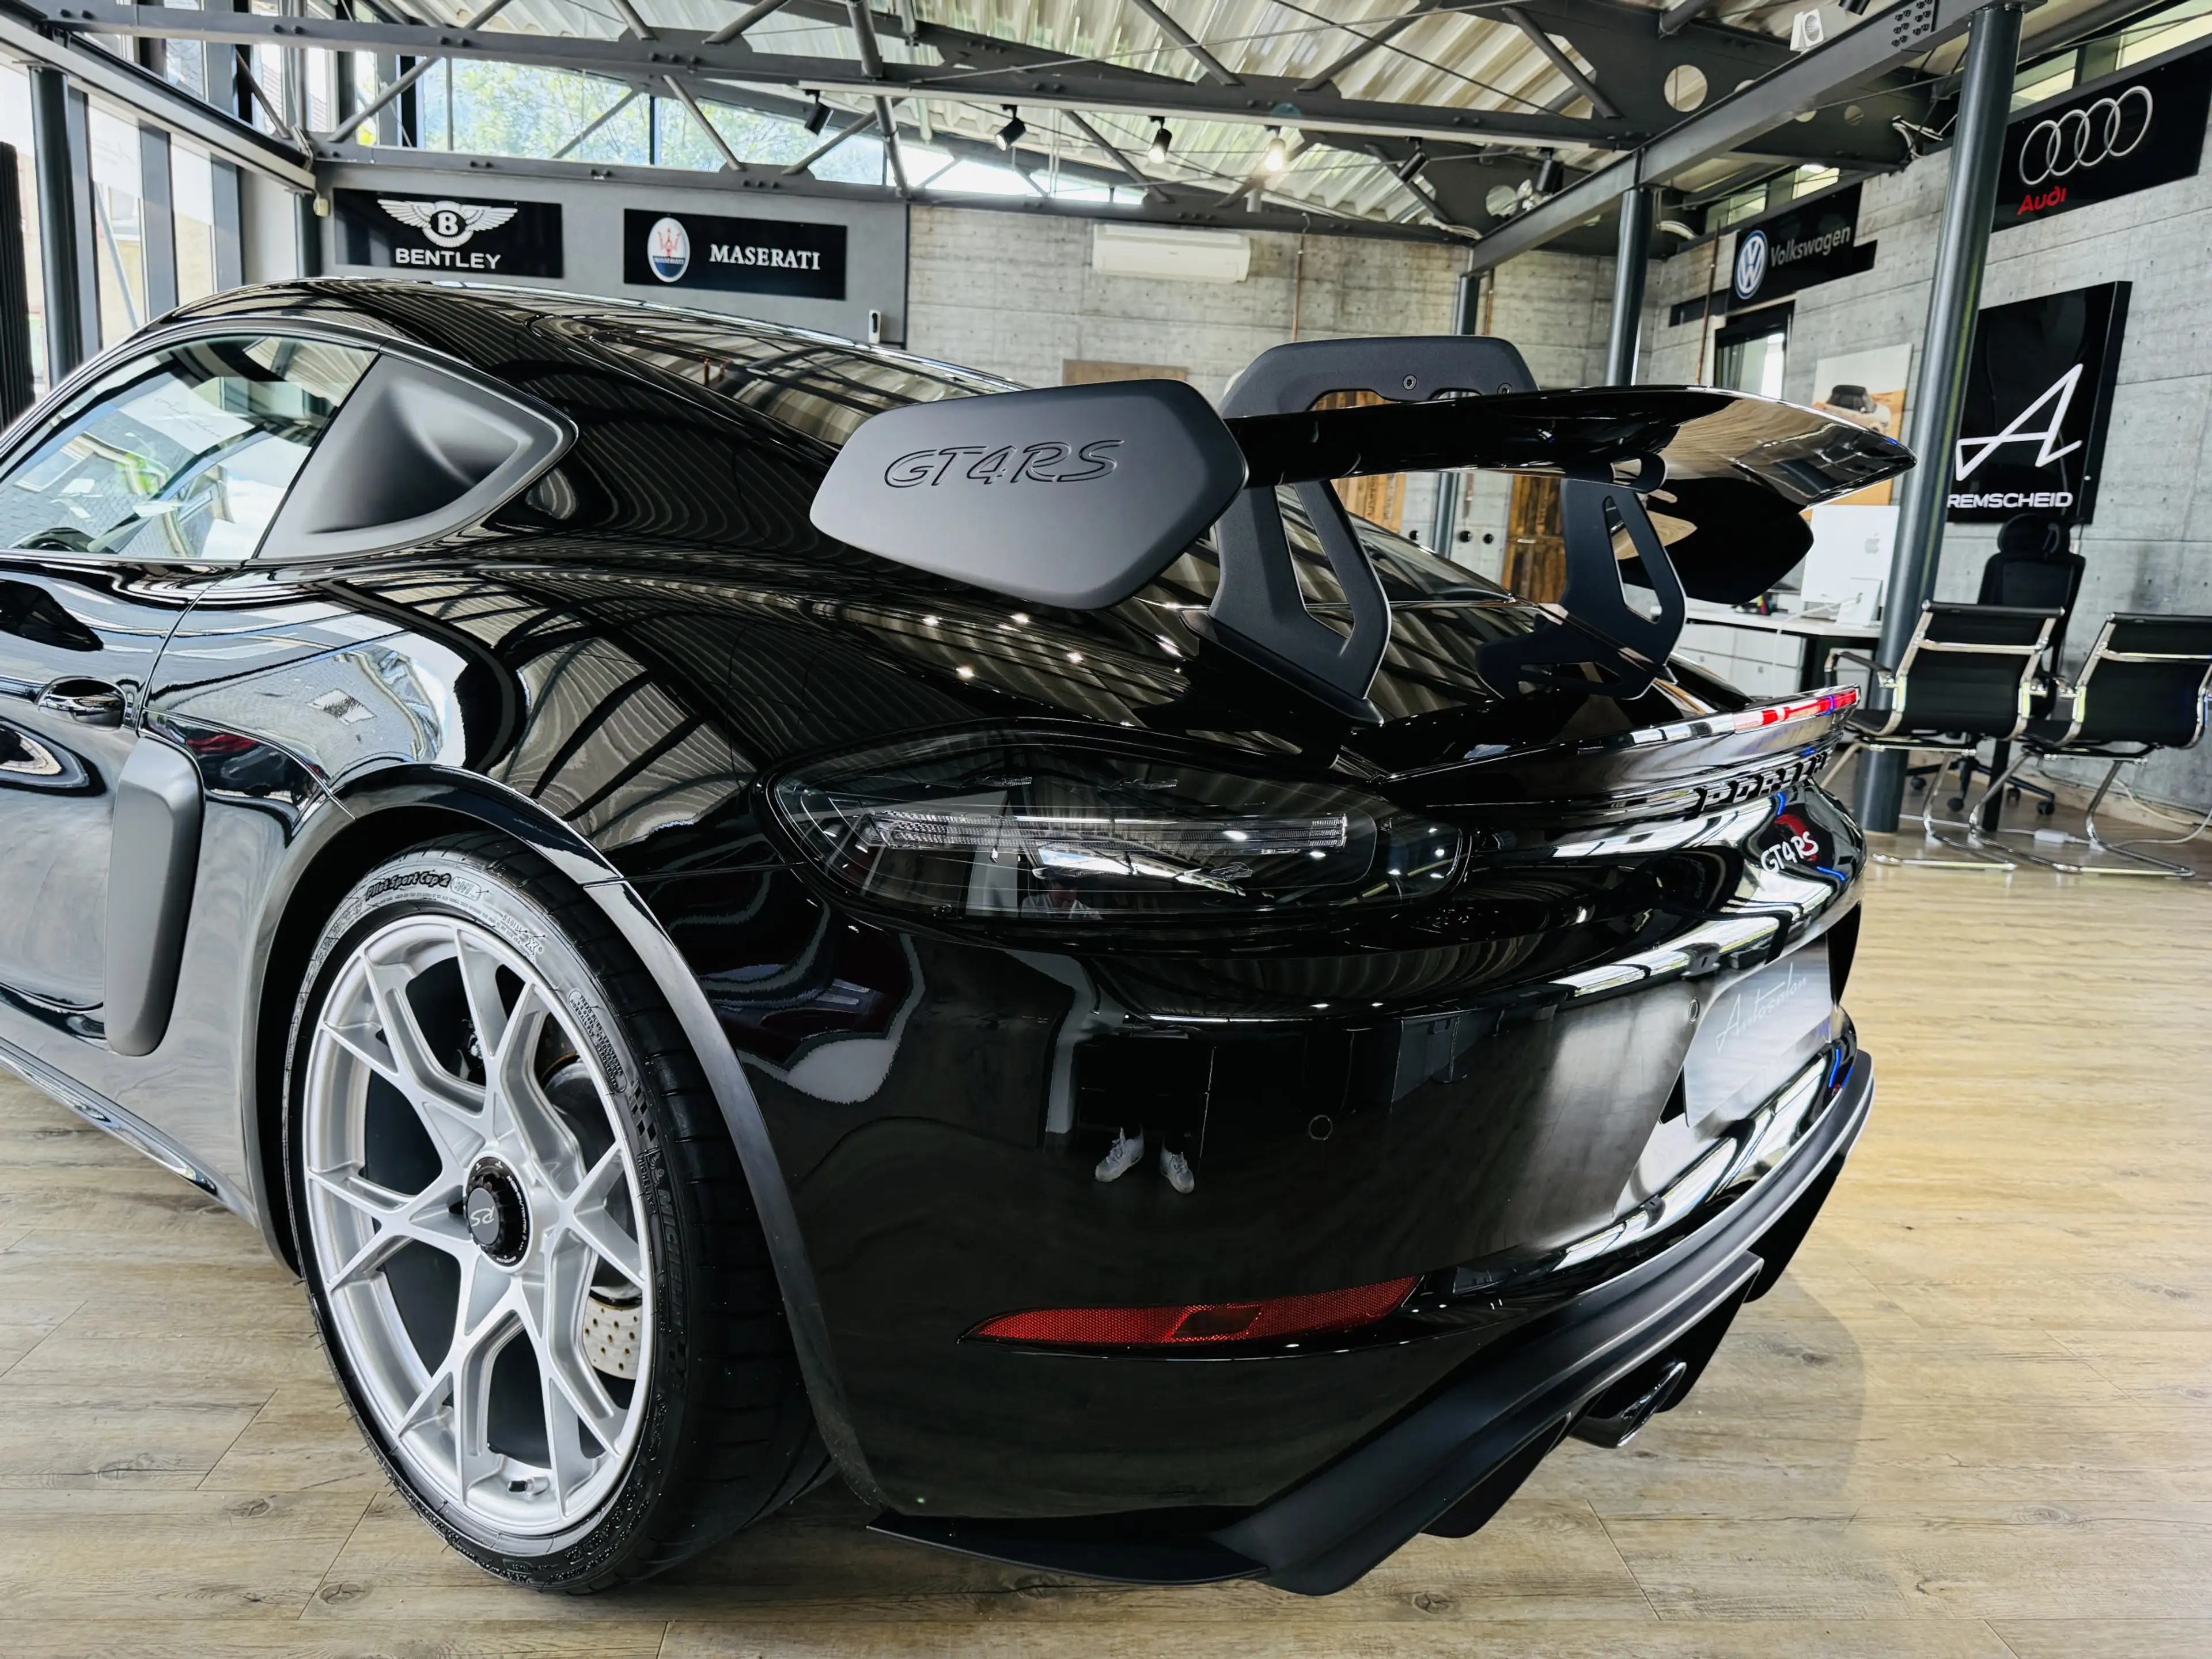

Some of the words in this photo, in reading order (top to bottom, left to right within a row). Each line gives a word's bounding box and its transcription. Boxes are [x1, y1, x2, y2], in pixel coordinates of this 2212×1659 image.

[2017, 185, 2067, 215] Audi
[438, 211, 459, 236] B
[395, 248, 501, 270] BENTLEY
[709, 243, 821, 270] MASERATI
[1770, 225, 1851, 267] Volkswagen
[884, 440, 1124, 488] GT4RS
[1946, 491, 2073, 508] REMSCHEID
[1760, 831, 1819, 874] GT4RS
[387, 872, 418, 891] Sport
[418, 870, 440, 888] Cup
[438, 873, 451, 888] 2
